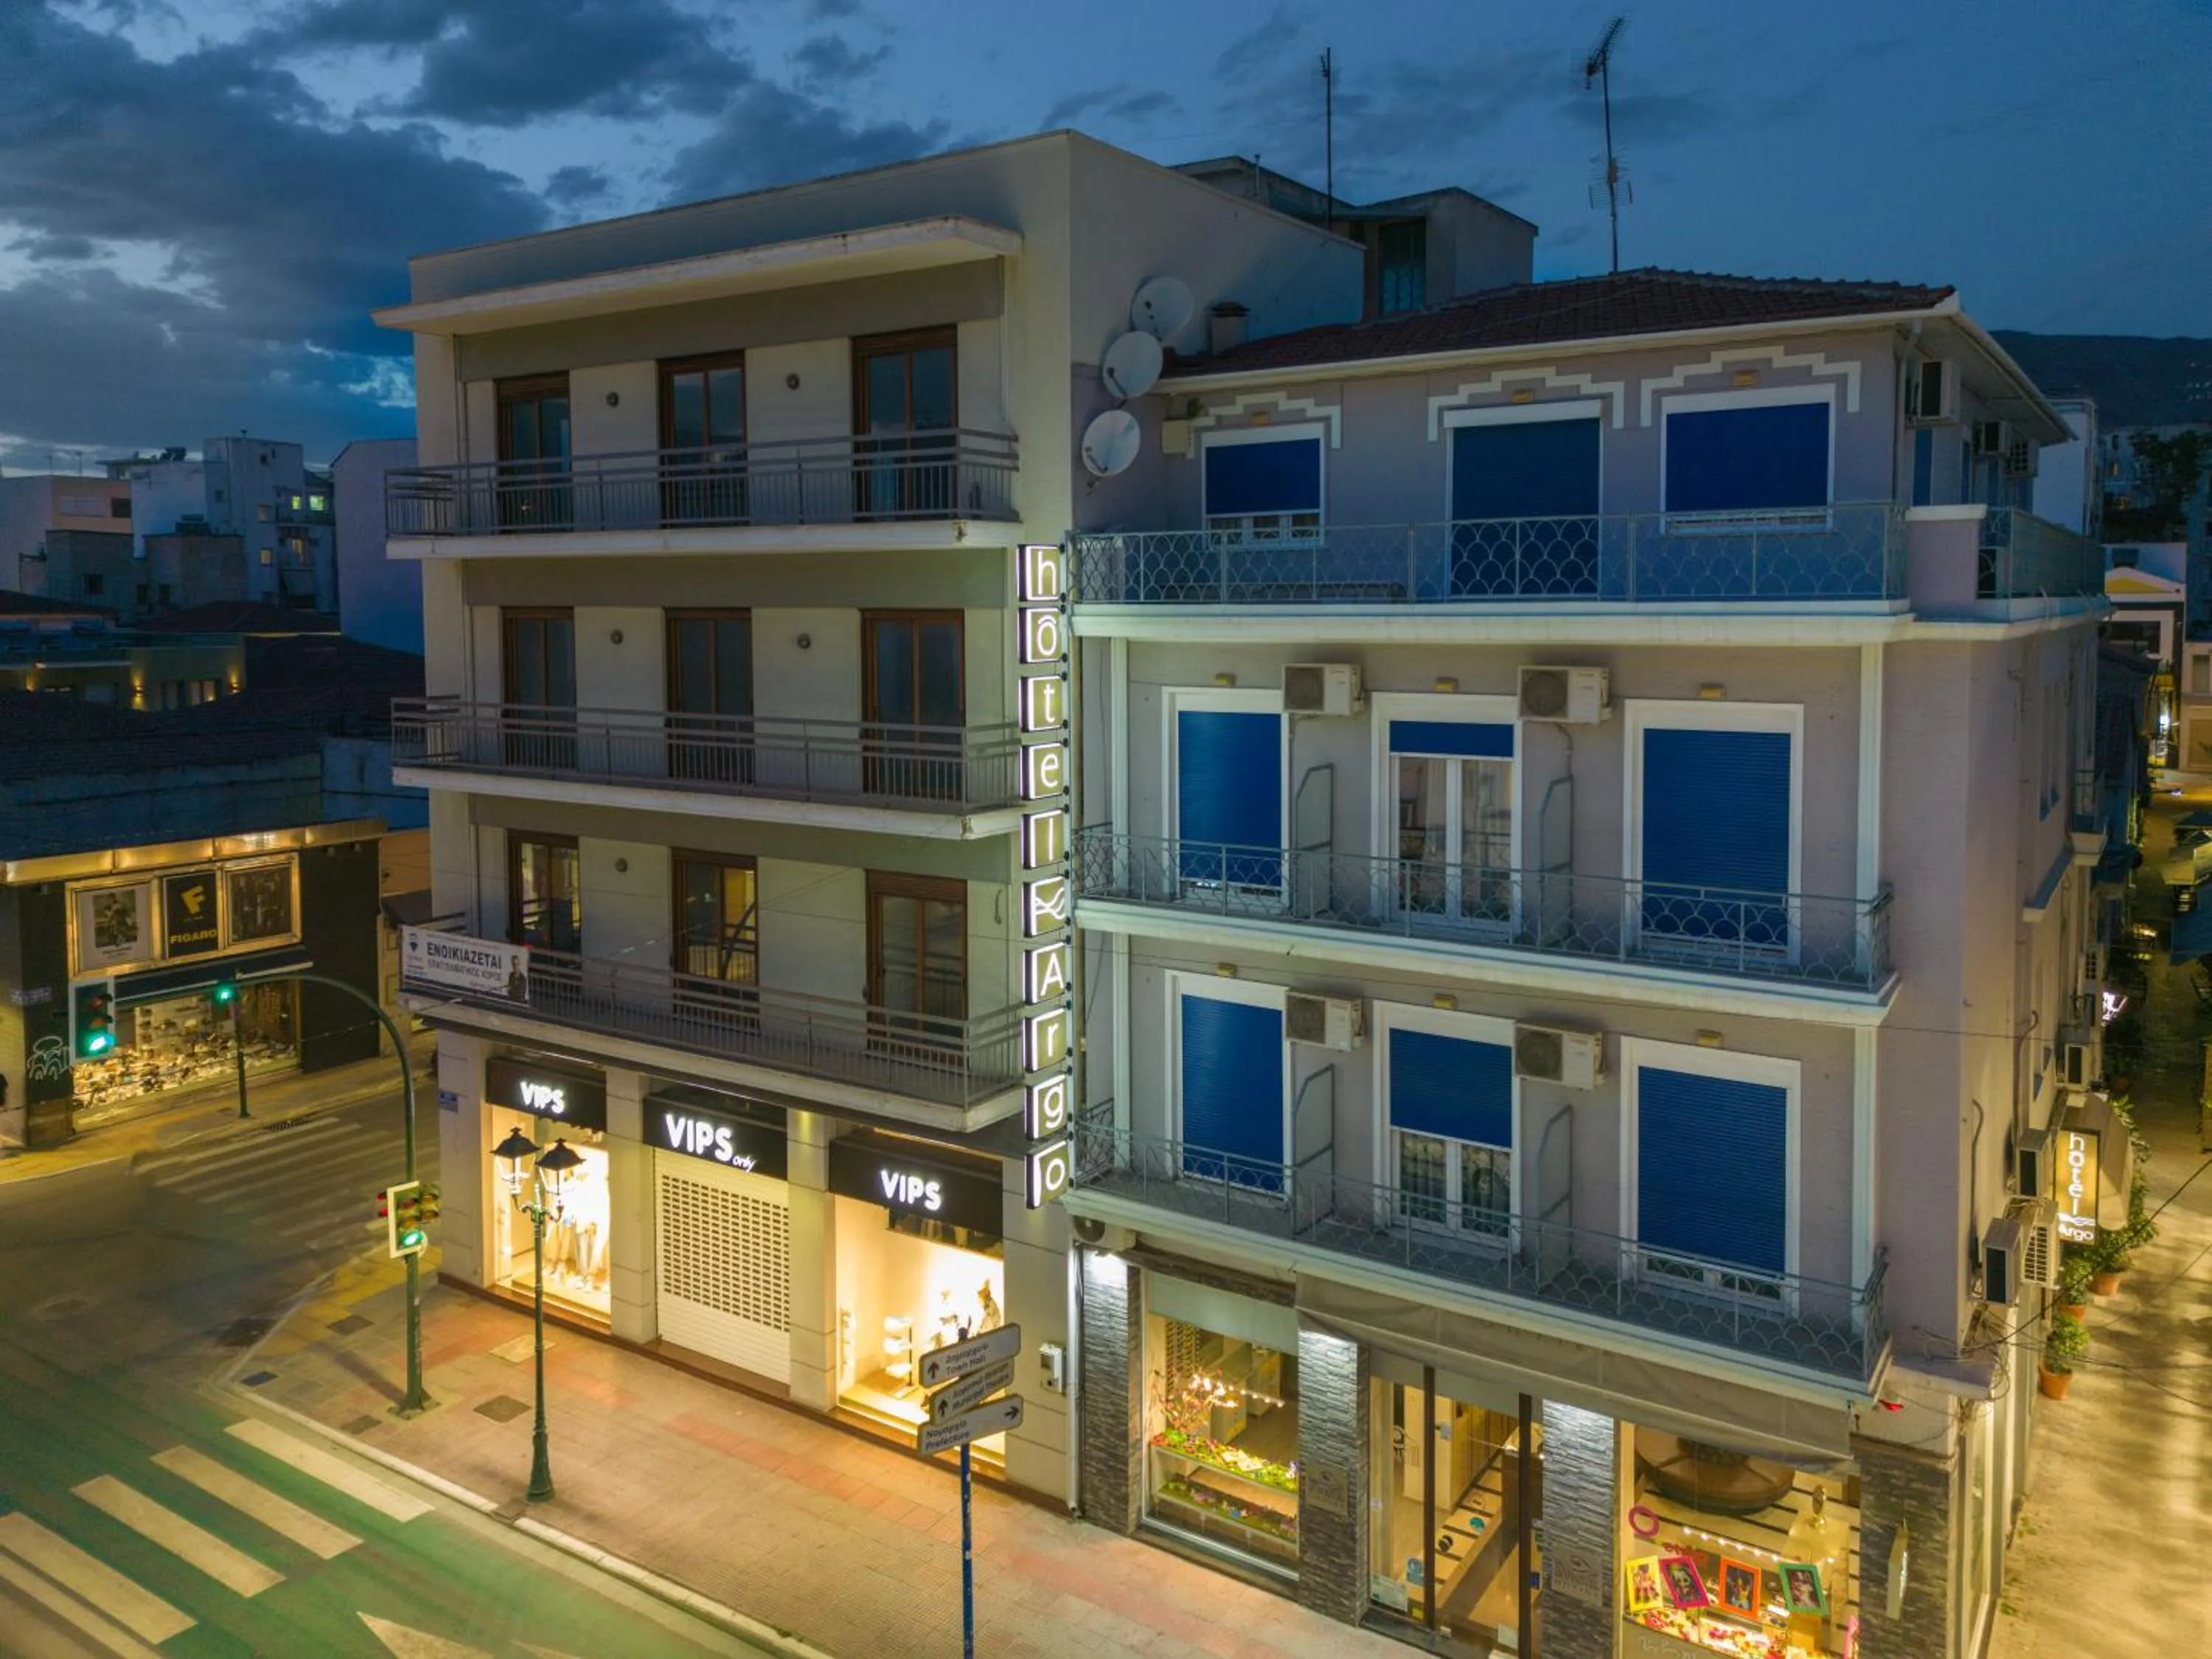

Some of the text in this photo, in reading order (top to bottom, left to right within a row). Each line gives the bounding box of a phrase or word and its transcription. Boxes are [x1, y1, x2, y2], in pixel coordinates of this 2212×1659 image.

[170, 929, 218, 945] FIGARO
[1040, 952, 1065, 1192] Argo
[520, 1081, 564, 1113] VIPS
[666, 1113, 758, 1172] VIPS only
[880, 1169, 942, 1211] VIPS
[946, 1354, 987, 1376] Town Hall
